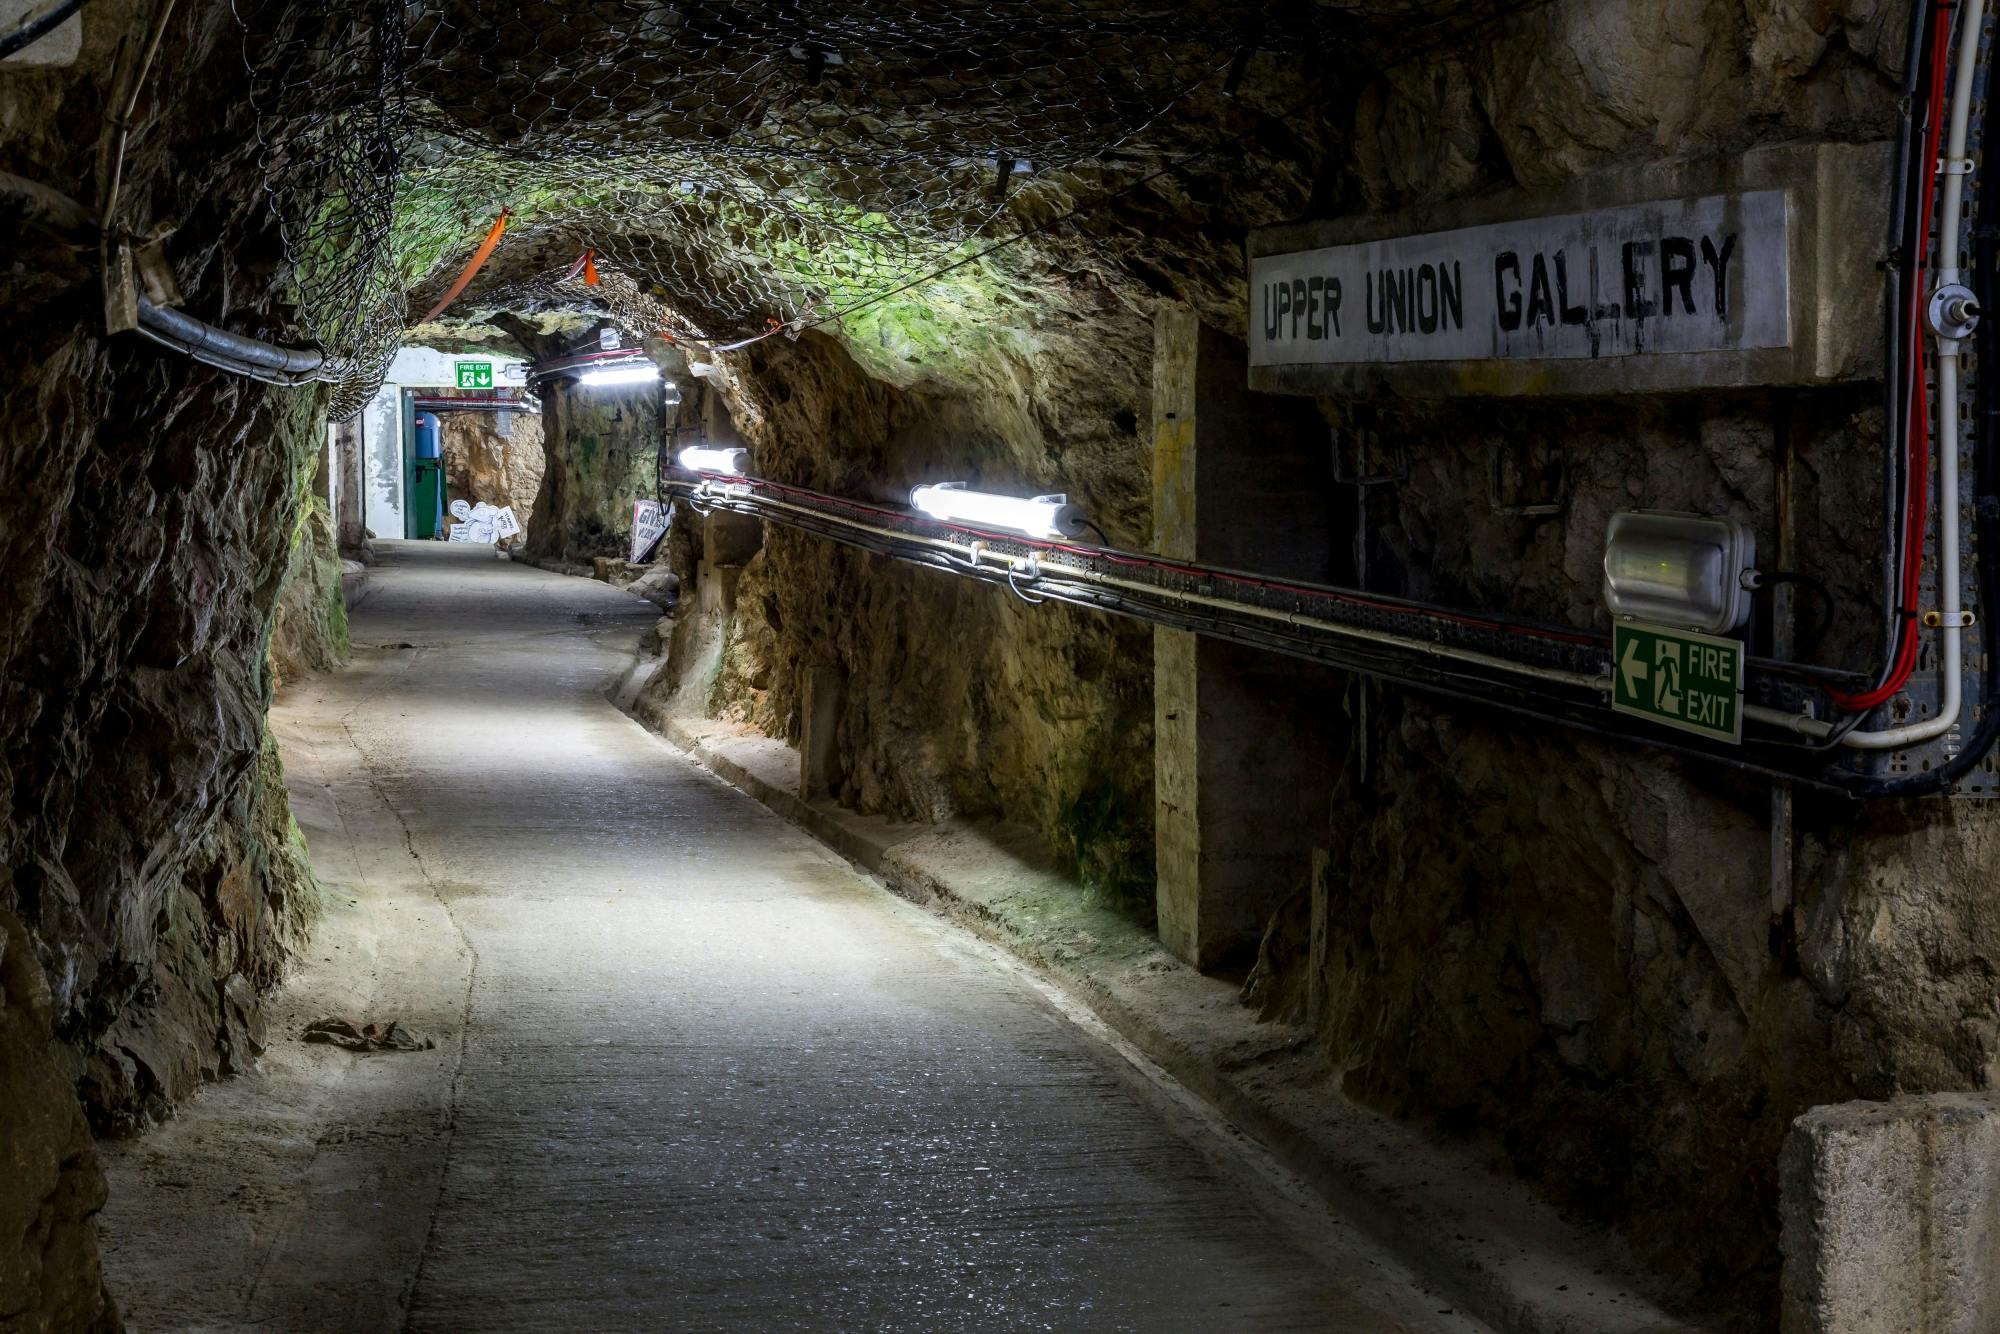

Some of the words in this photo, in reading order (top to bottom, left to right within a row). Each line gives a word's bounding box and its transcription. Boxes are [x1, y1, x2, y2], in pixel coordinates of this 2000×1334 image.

[1264, 276, 1341, 341] UPPER
[1366, 259, 1463, 335] UNION
[1496, 233, 1738, 334] GALLERY
[1689, 645, 1731, 683] FIRE
[1687, 690, 1730, 727] EXIT
